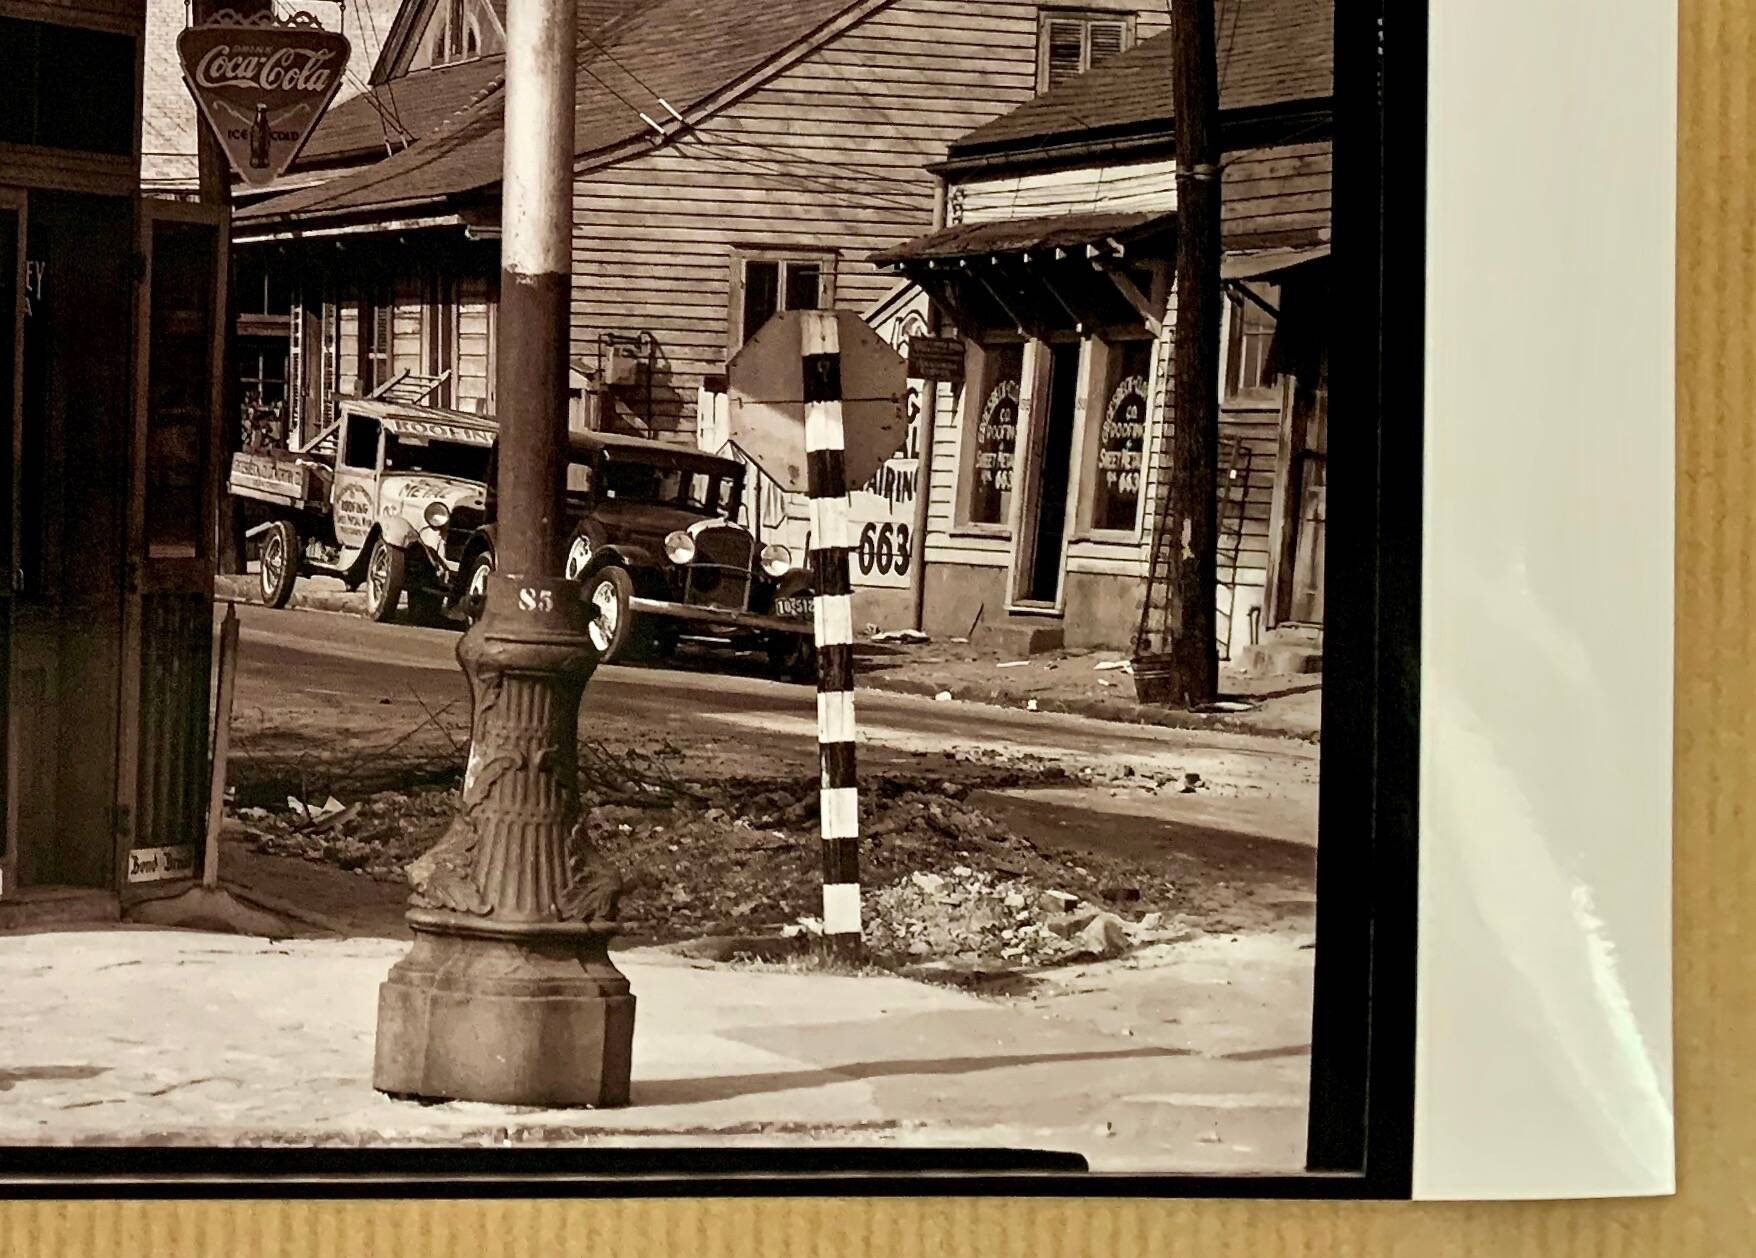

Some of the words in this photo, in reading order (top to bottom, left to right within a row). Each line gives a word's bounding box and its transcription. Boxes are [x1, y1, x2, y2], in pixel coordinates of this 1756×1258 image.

[195, 44, 337, 92] Coca-Cola
[227, 129, 249, 140] ICE
[270, 129, 300, 142] COLD
[858, 521, 910, 577] 663
[518, 587, 554, 612] 85
